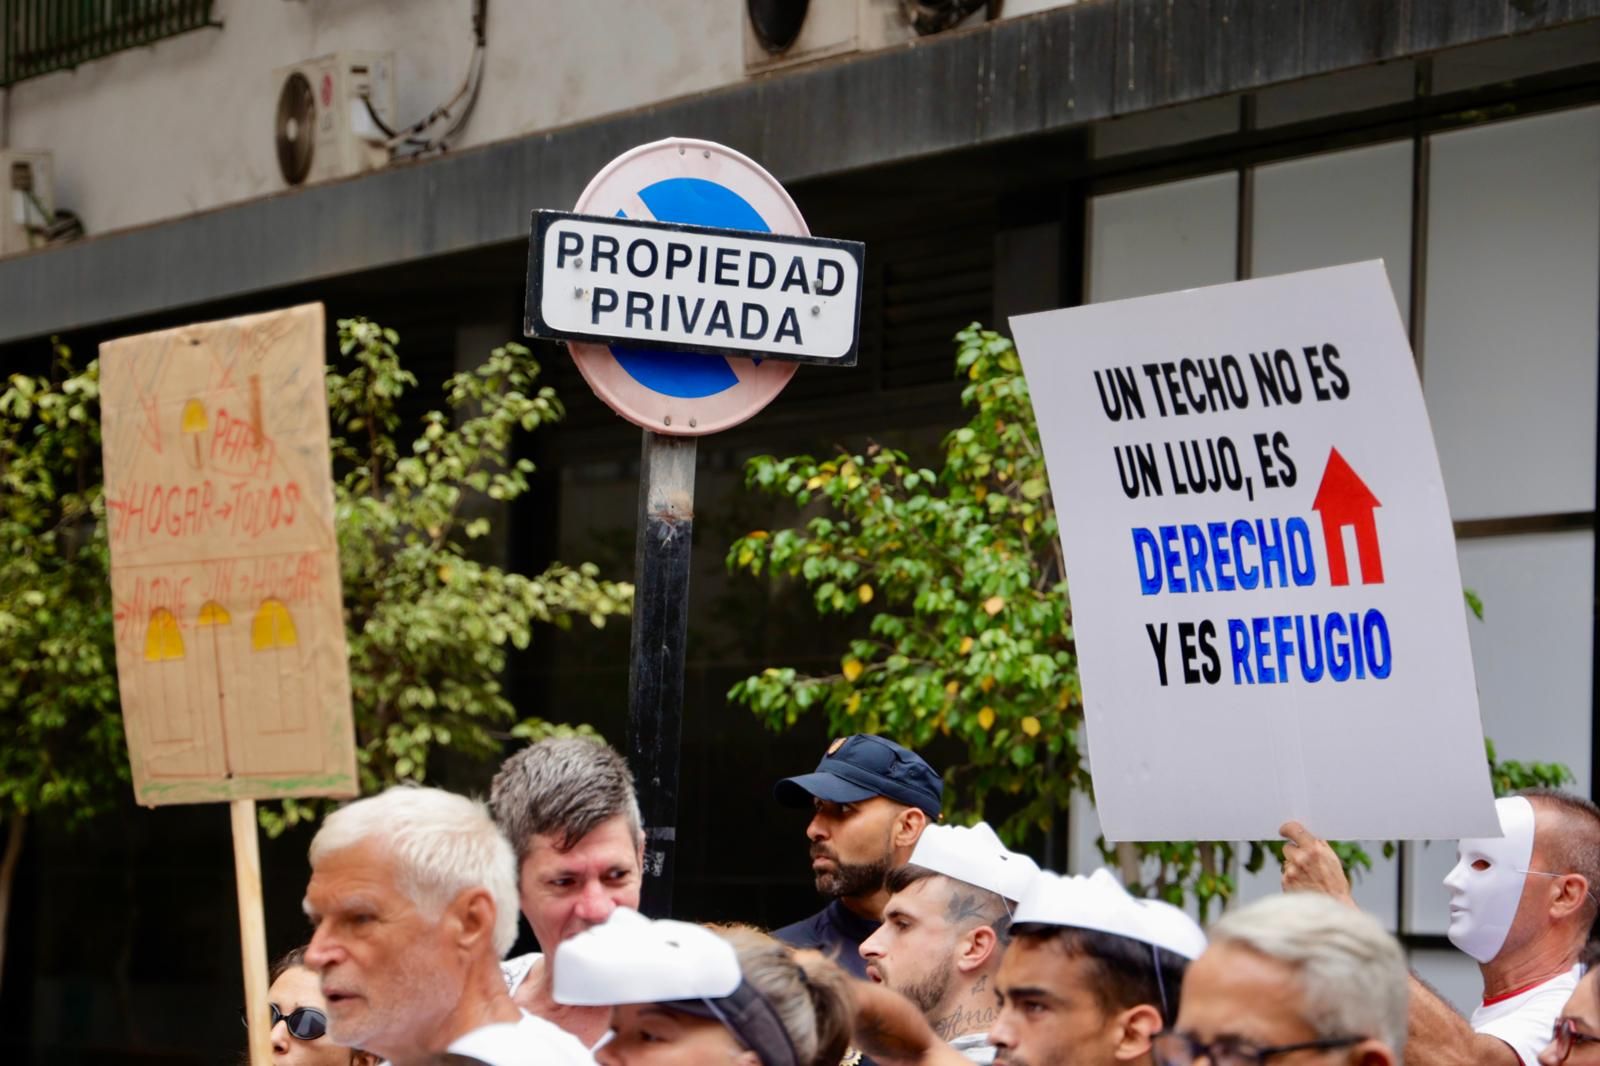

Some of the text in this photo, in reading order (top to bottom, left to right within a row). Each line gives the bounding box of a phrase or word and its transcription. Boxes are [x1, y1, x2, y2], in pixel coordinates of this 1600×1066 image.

[557, 231, 844, 296] PROPIEDAD
[592, 287, 803, 345] PRIVADA
[1093, 342, 1351, 421] UN TECHO NO ES
[1113, 430, 1298, 502] UN LUJO, ES
[1131, 516, 1316, 596] DERECHO
[1145, 608, 1392, 686] Y ES REFUGIO
